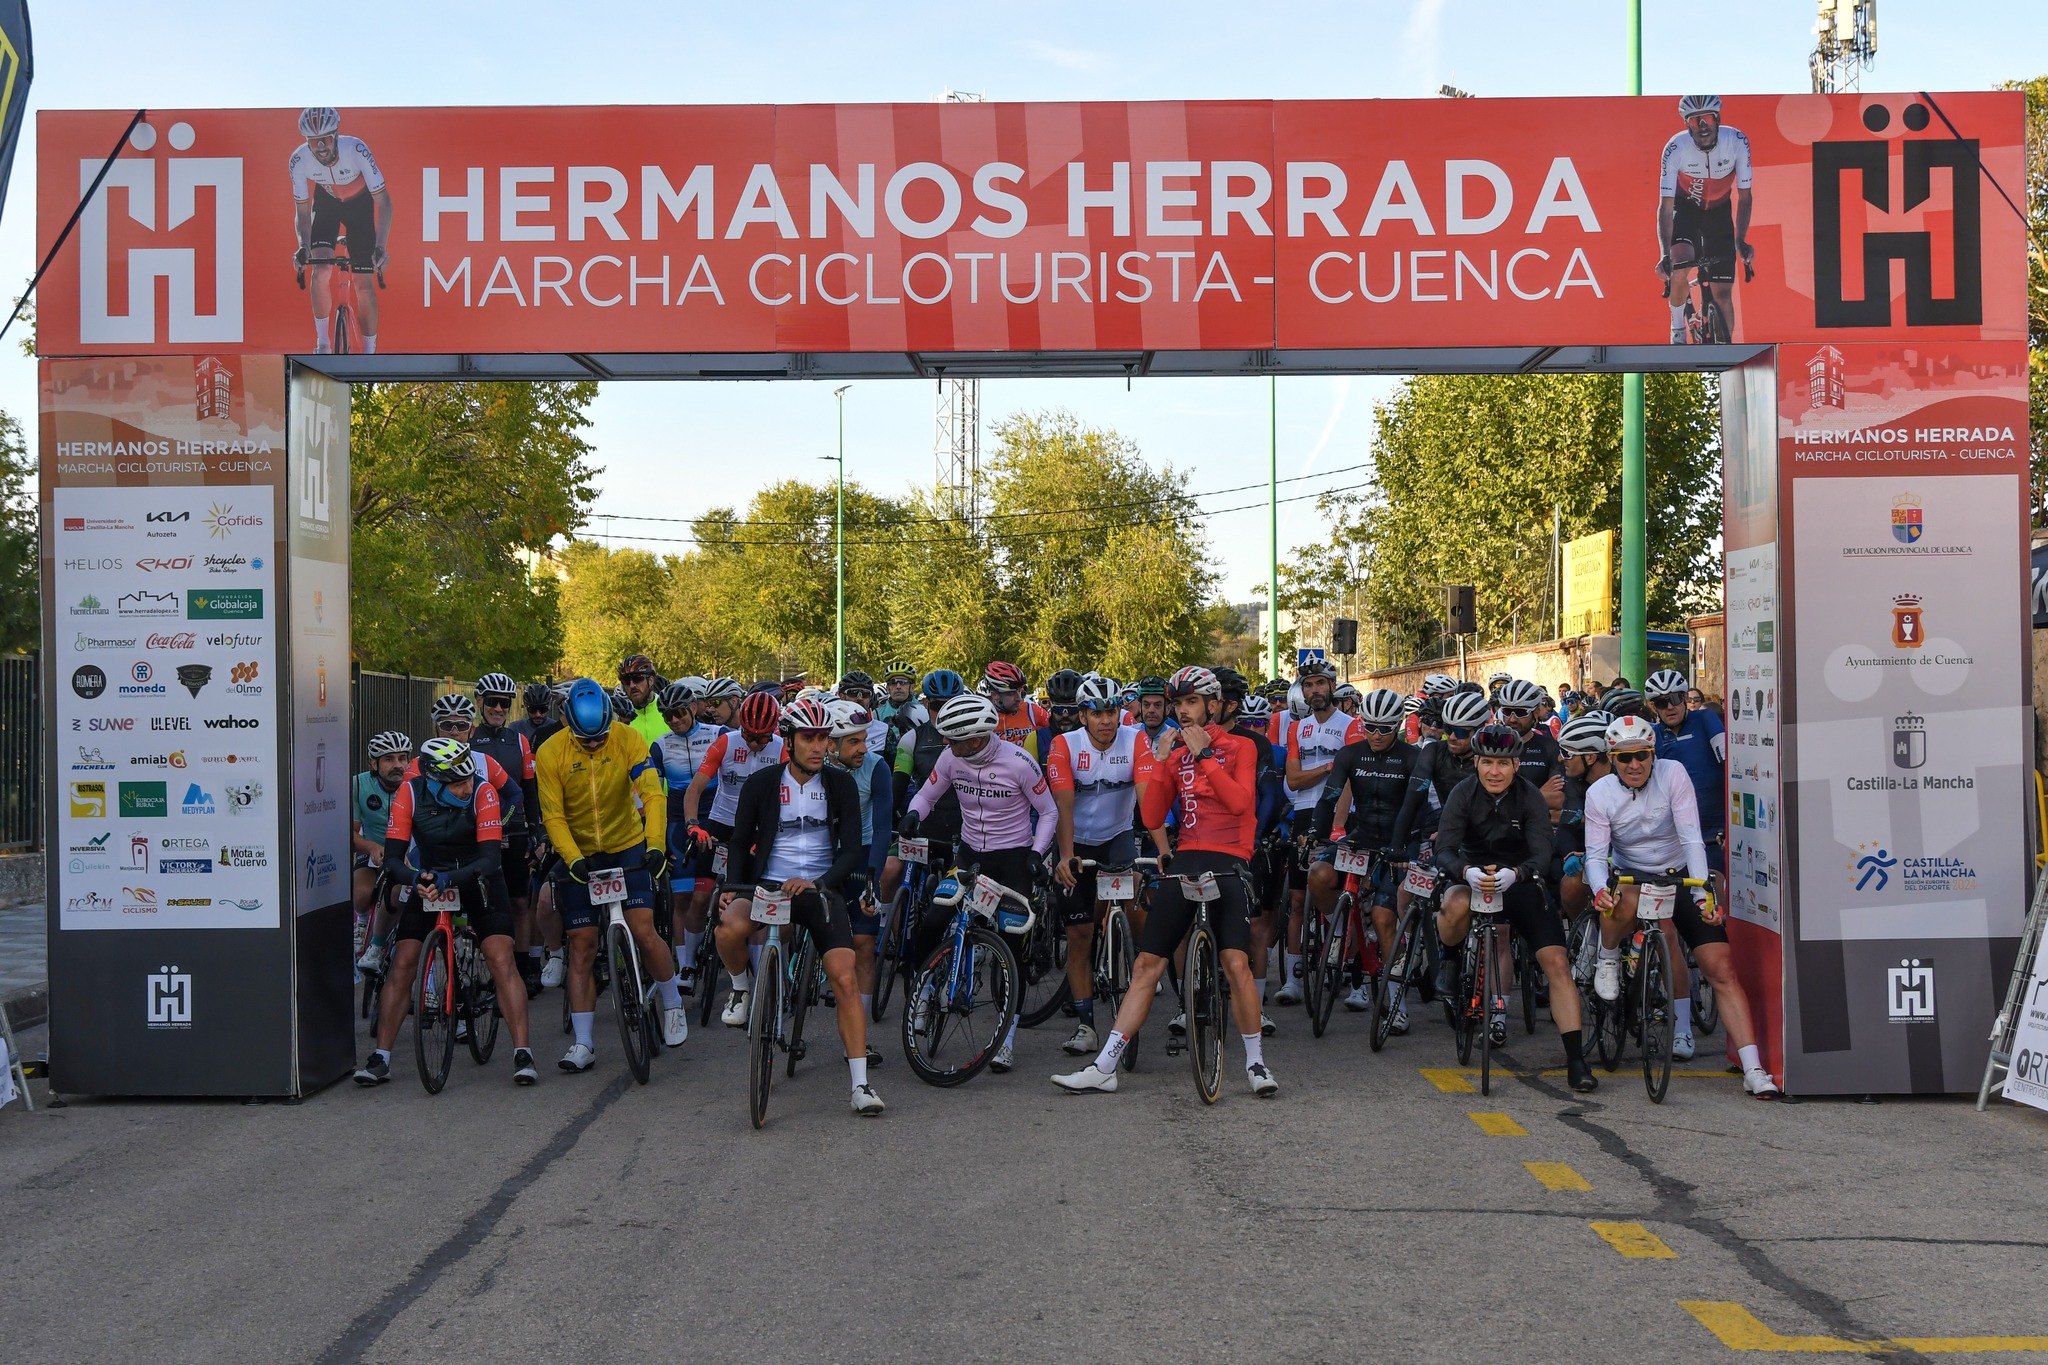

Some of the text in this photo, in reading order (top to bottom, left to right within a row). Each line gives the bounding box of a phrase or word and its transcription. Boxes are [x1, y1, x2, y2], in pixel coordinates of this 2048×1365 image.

[422, 157, 1602, 242] HERMANOS HERRADA
[424, 254, 725, 307] MARCHA
[1308, 247, 1604, 304] CUENCA
[1794, 427, 2015, 445] HERMANOS HERRADA
[57, 440, 272, 457] HERMANOS HERRADA
[1795, 451, 1852, 462] MARCHA
[1855, 450, 1948, 461] CICLOTURISTA
[1959, 449, 2016, 460] CUENCA
[57, 462, 114, 474] MARCHA
[118, 461, 207, 473] CICLOTURISTA
[219, 461, 272, 472] CUENCA
[217, 515, 263, 526] Cofidis
[1843, 546, 1887, 555] DIPUTACIÓN
[1888, 546, 1930, 554] PROVINCIAL
[64, 558, 123, 570] HELIOS
[209, 600, 258, 611] Globalcaja
[146, 632, 198, 649] Coca-Cola
[206, 633, 262, 649] velofutur
[1845, 655, 1974, 669] Ayuntamiento de Cuenca
[76, 674, 103, 688] ROMERA
[119, 683, 166, 693] moneda
[203, 714, 259, 729] wahoo
[130, 755, 167, 764] amiab
[1847, 775, 1974, 791] Castilla-La Mancha
[181, 806, 215, 814] MEDYPLAN
[162, 838, 210, 848] ORTEGA
[231, 849, 265, 858] Mota del
[901, 844, 923, 858] 341
[160, 861, 198, 869] VICTORY
[234, 858, 267, 867] Cuervo
[1341, 852, 1365, 867] 173
[1903, 858, 1964, 867] CASTILLA-
[1904, 868, 1976, 878] LA MANCHA
[1111, 878, 1120, 890] 4
[1410, 872, 1435, 890] 326
[1953, 880, 1977, 890] 2024
[593, 880, 622, 896] 370
[1195, 887, 1203, 896] 1
[980, 889, 995, 906] 11
[1483, 893, 1493, 904] 6
[766, 904, 777, 916] 2
[1654, 898, 1664, 911] 7
